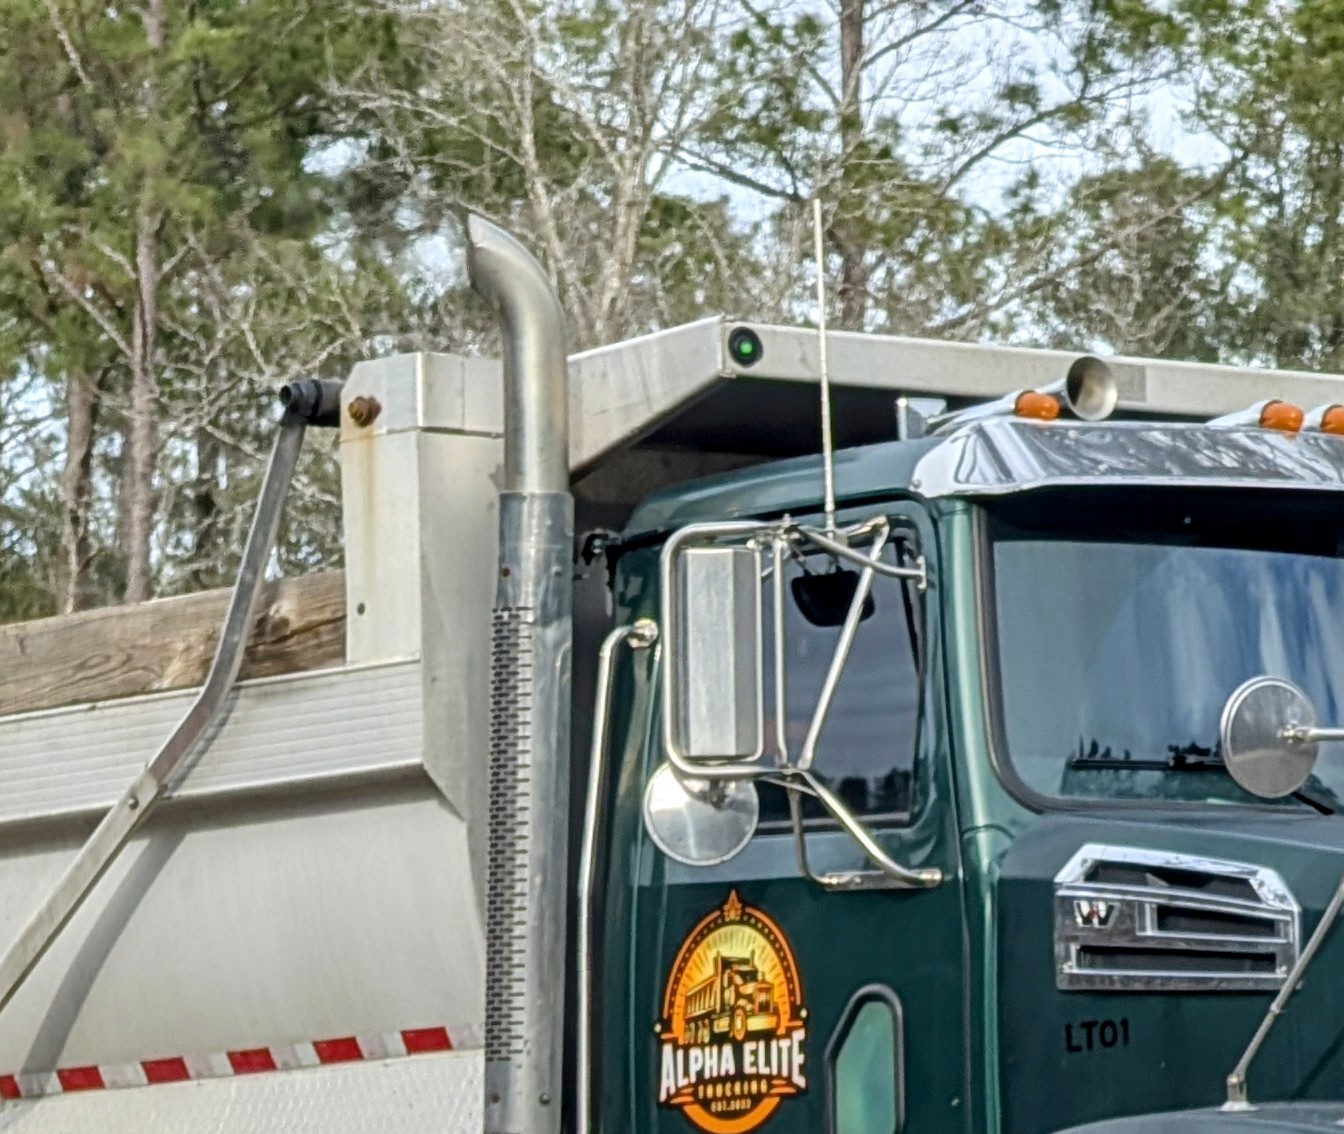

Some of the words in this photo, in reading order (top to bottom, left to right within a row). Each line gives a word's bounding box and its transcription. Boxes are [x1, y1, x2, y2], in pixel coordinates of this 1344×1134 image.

[1064, 1017, 1131, 1053] LT01
[659, 1043, 736, 1103] ALPHA
[743, 1030, 806, 1089] ELITE
